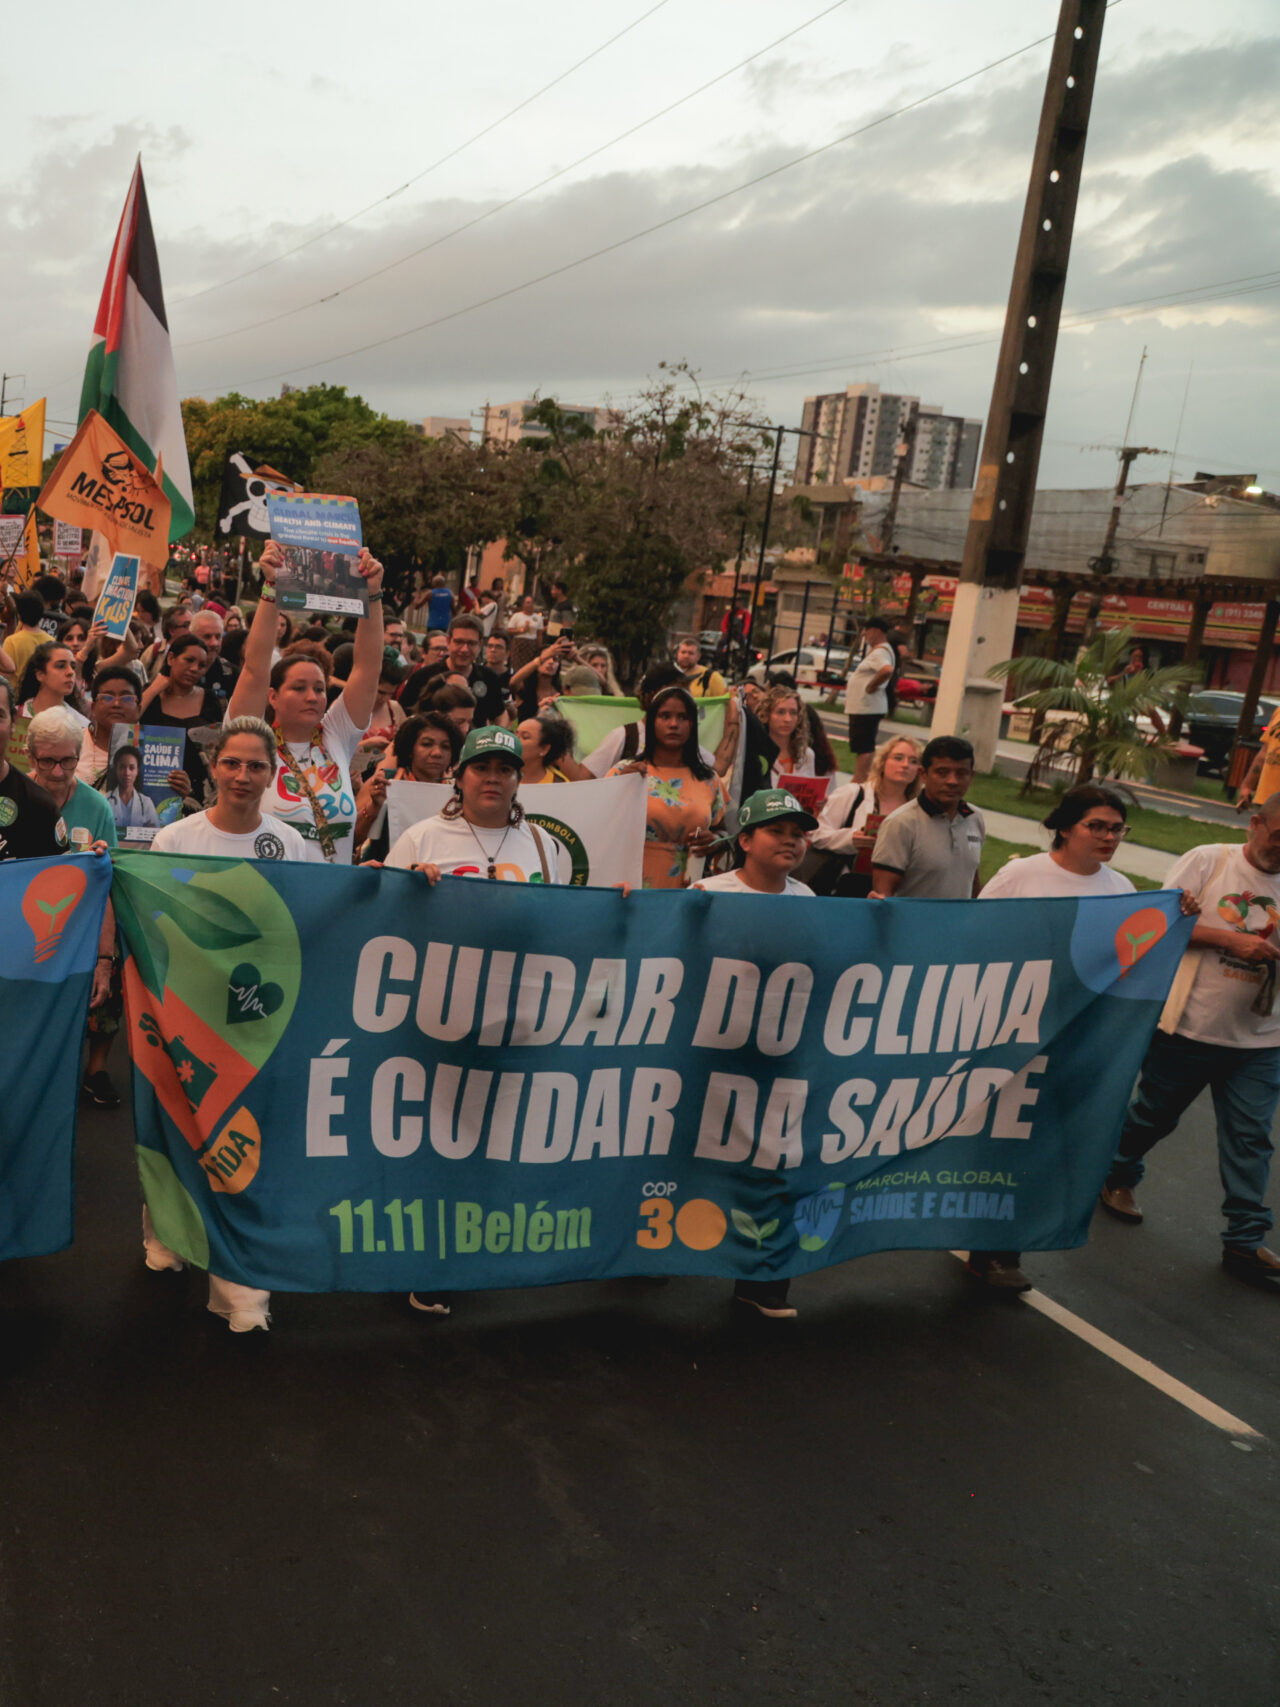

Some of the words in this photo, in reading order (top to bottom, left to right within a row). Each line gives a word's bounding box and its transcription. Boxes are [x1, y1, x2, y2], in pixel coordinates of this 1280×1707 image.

[144, 742, 173, 756] SAÚDE
[494, 731, 515, 750] GTA
[142, 754, 180, 769] CLIMA
[352, 935, 685, 1047] CUIDAR
[691, 957, 816, 1057] DO
[823, 960, 1053, 1057] CLIMA
[305, 1038, 351, 1158] É
[370, 1056, 683, 1165] CUIDAR
[694, 1071, 810, 1171] DA
[820, 1055, 1048, 1166] SAÚDE
[642, 1181, 678, 1198] COP
[855, 1170, 932, 1192] MARCHA
[936, 1169, 1019, 1187] GLOBAL
[849, 1187, 918, 1225] SAÚDE
[922, 1191, 938, 1220] E
[939, 1191, 1016, 1222] CLIMA
[329, 1198, 426, 1254] 11.11
[455, 1200, 592, 1255] Belém
